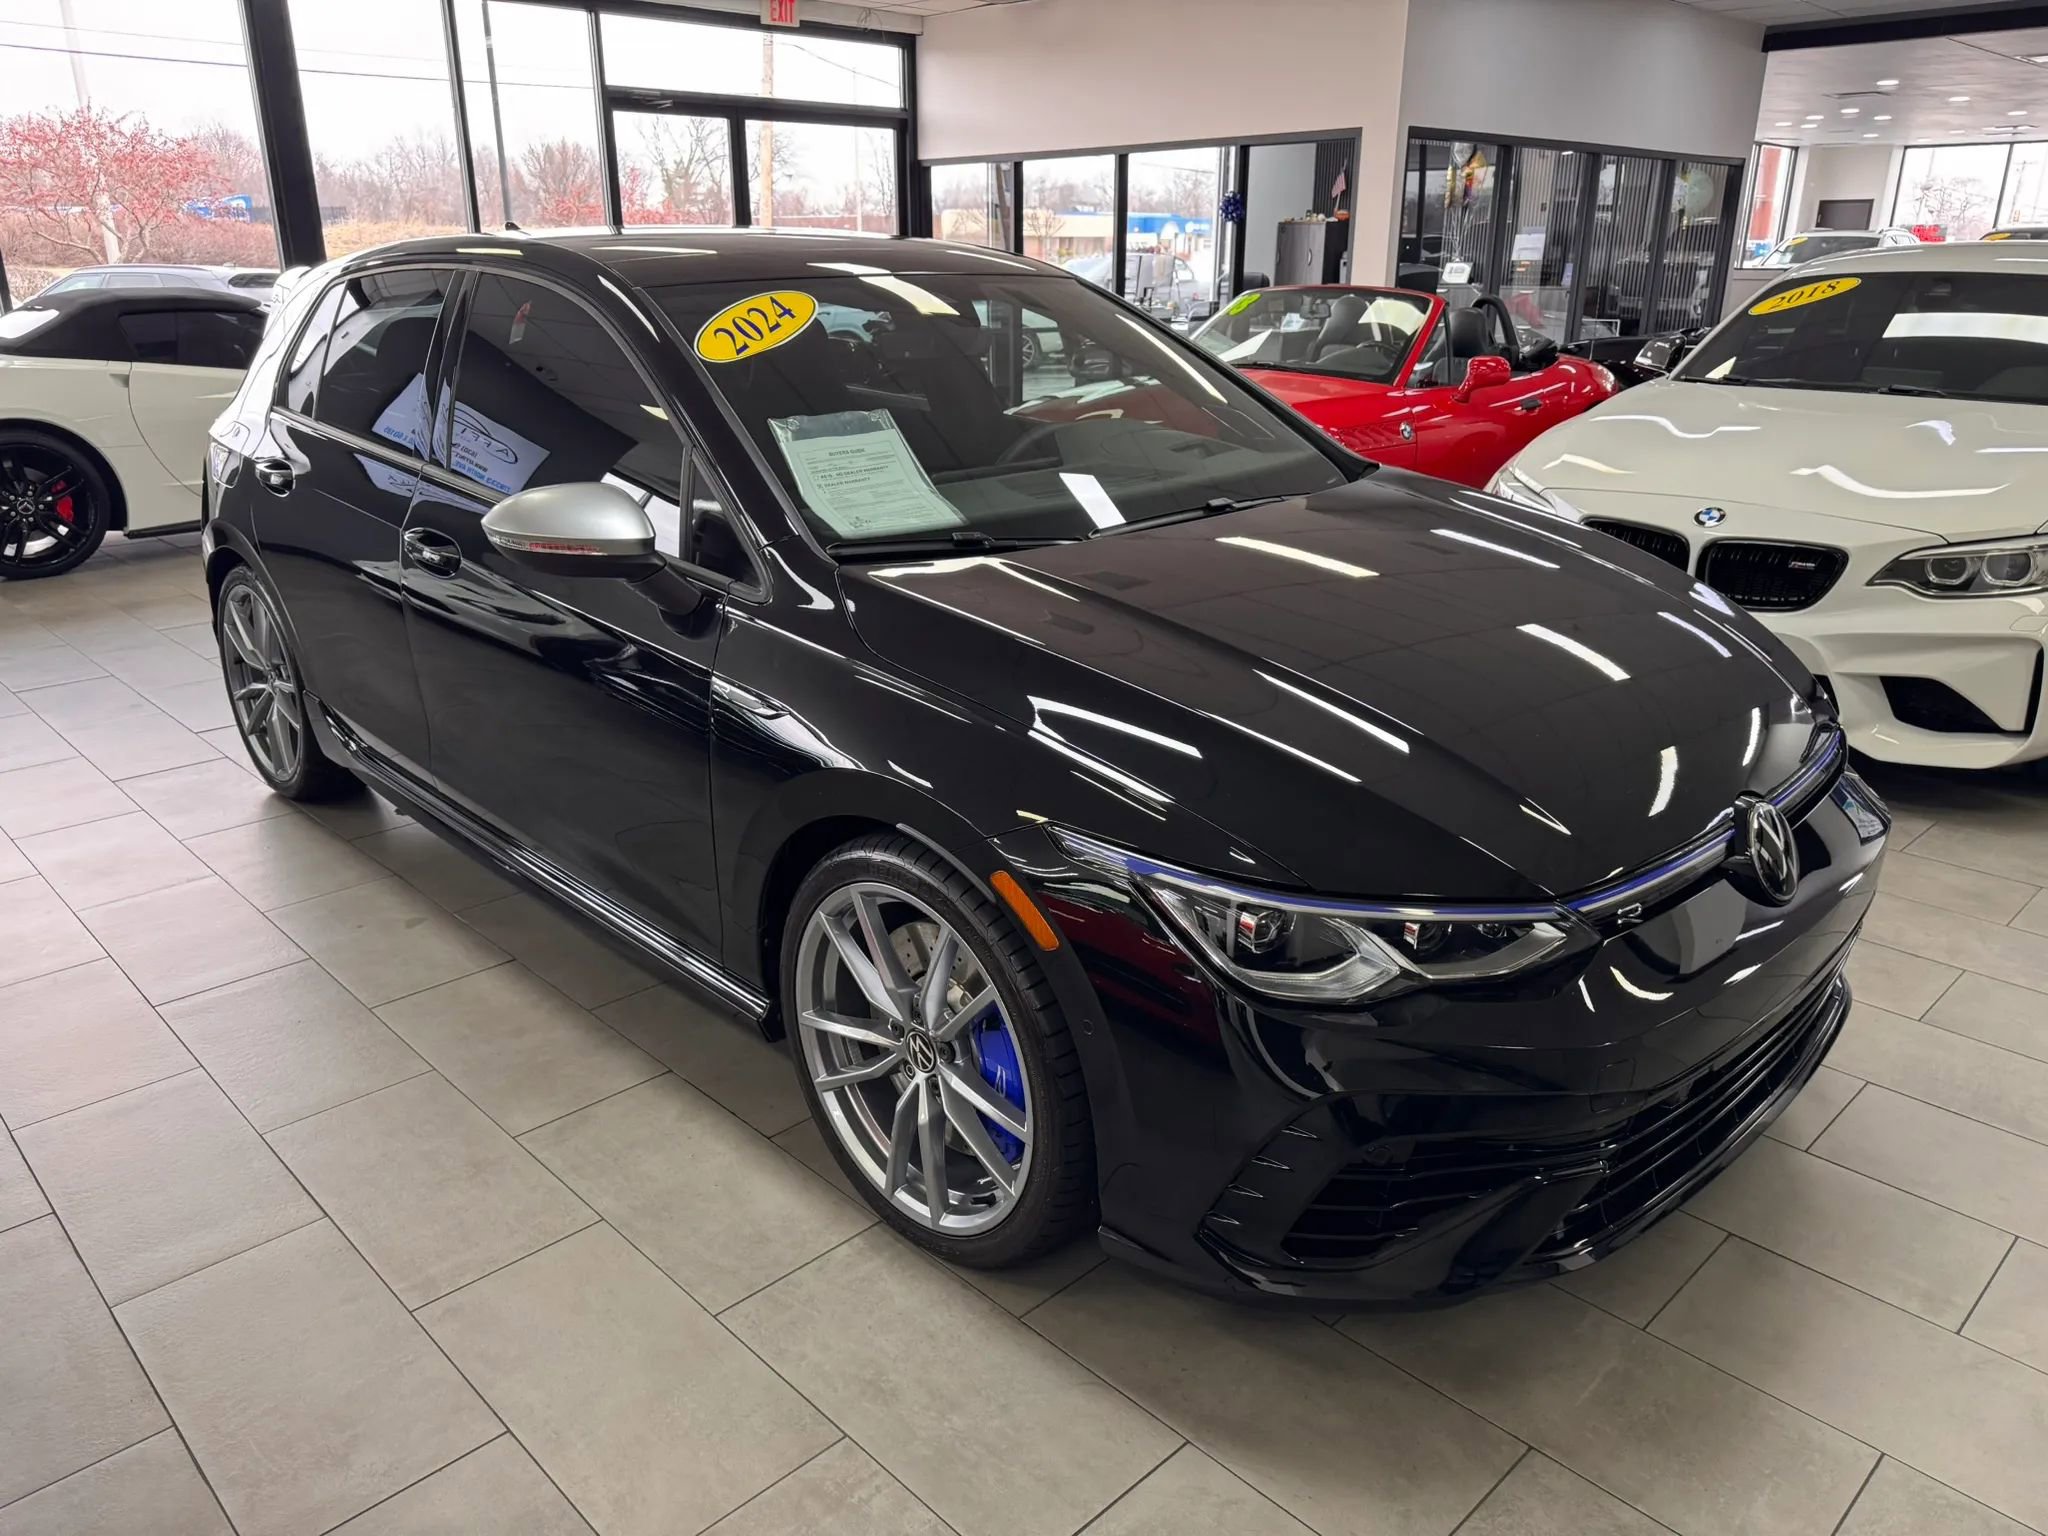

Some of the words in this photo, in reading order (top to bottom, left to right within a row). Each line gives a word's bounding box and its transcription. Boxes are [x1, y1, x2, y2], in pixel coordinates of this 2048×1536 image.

[768, 0, 796, 24] EXIT
[1767, 281, 1841, 311] 2018
[714, 296, 797, 355] 2024
[1617, 902, 1643, 924] R
